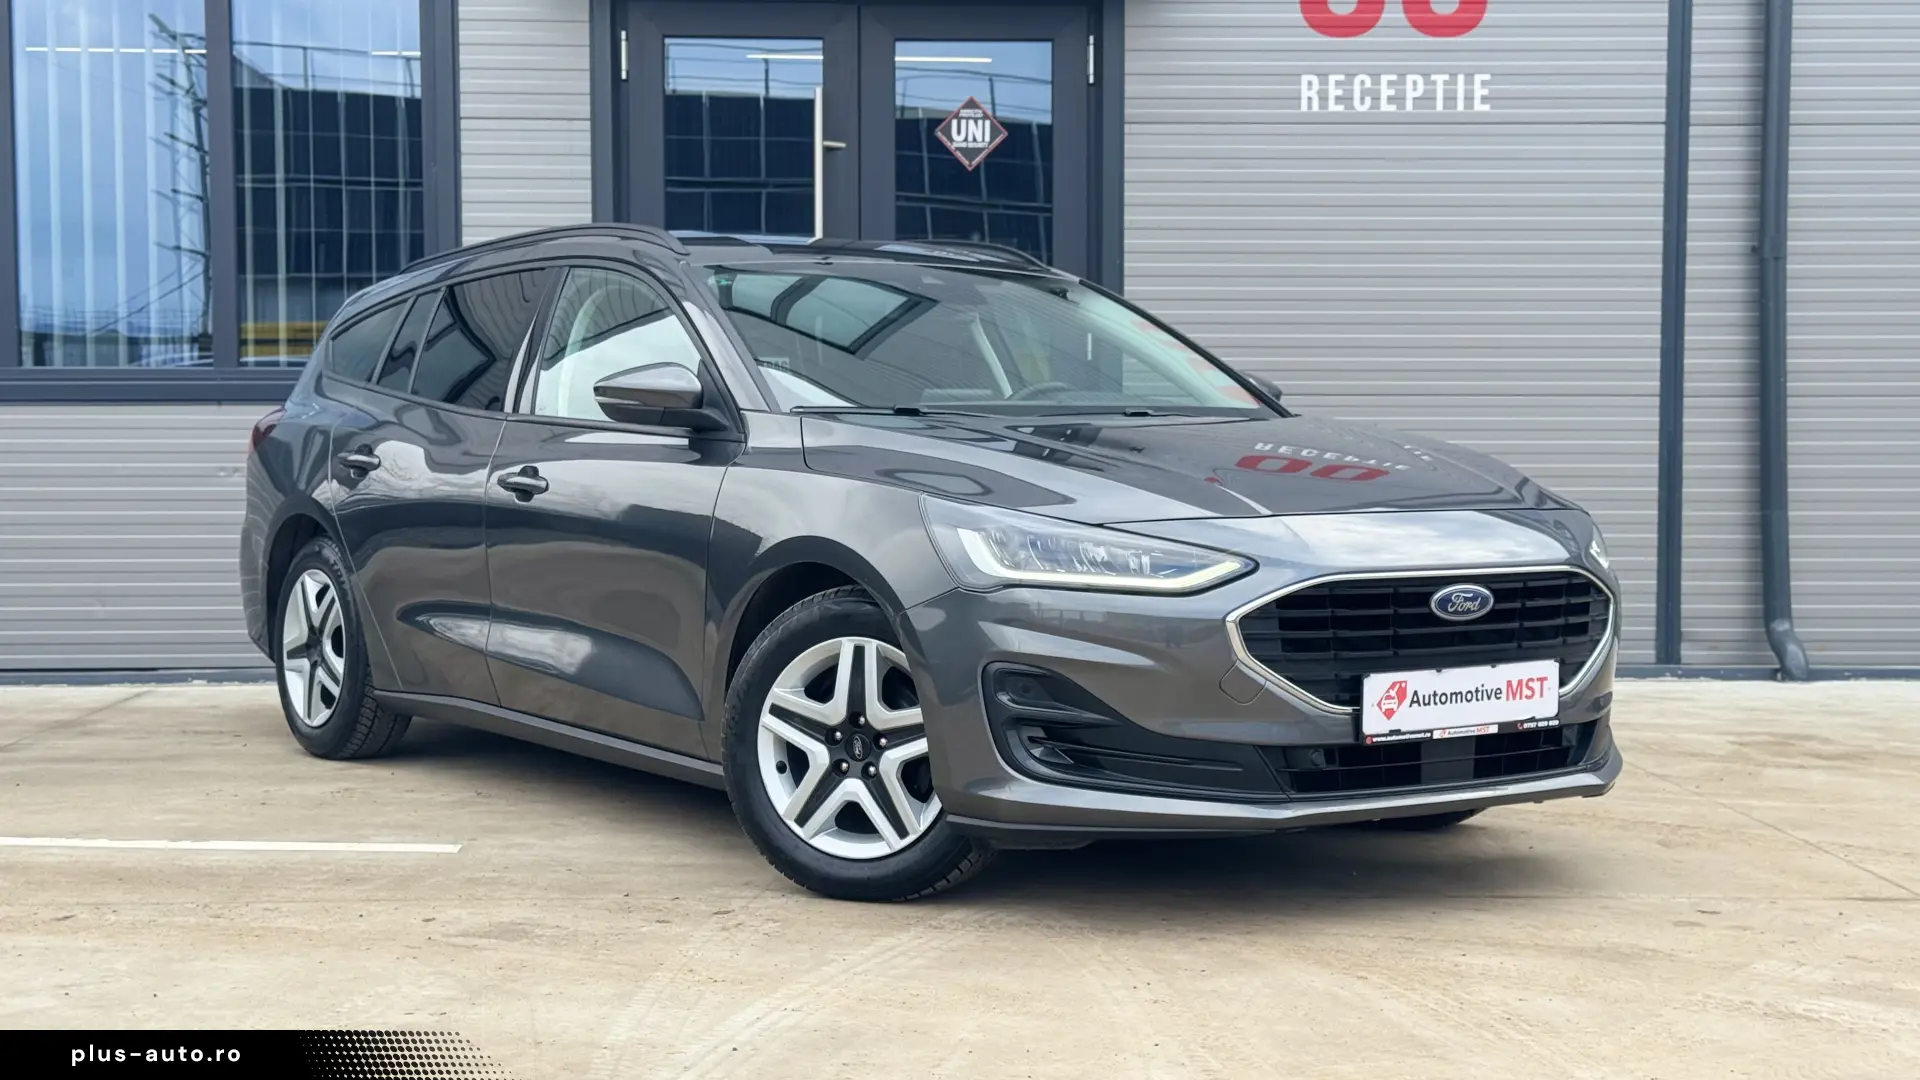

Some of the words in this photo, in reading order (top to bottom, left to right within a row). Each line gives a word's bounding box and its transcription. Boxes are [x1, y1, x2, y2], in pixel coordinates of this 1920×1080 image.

[1300, 73, 1492, 112] RECEPTIE
[951, 119, 990, 142] UNI
[1448, 592, 1481, 612] Ford
[1408, 684, 1503, 709] Automotive
[1505, 676, 1549, 702] MST
